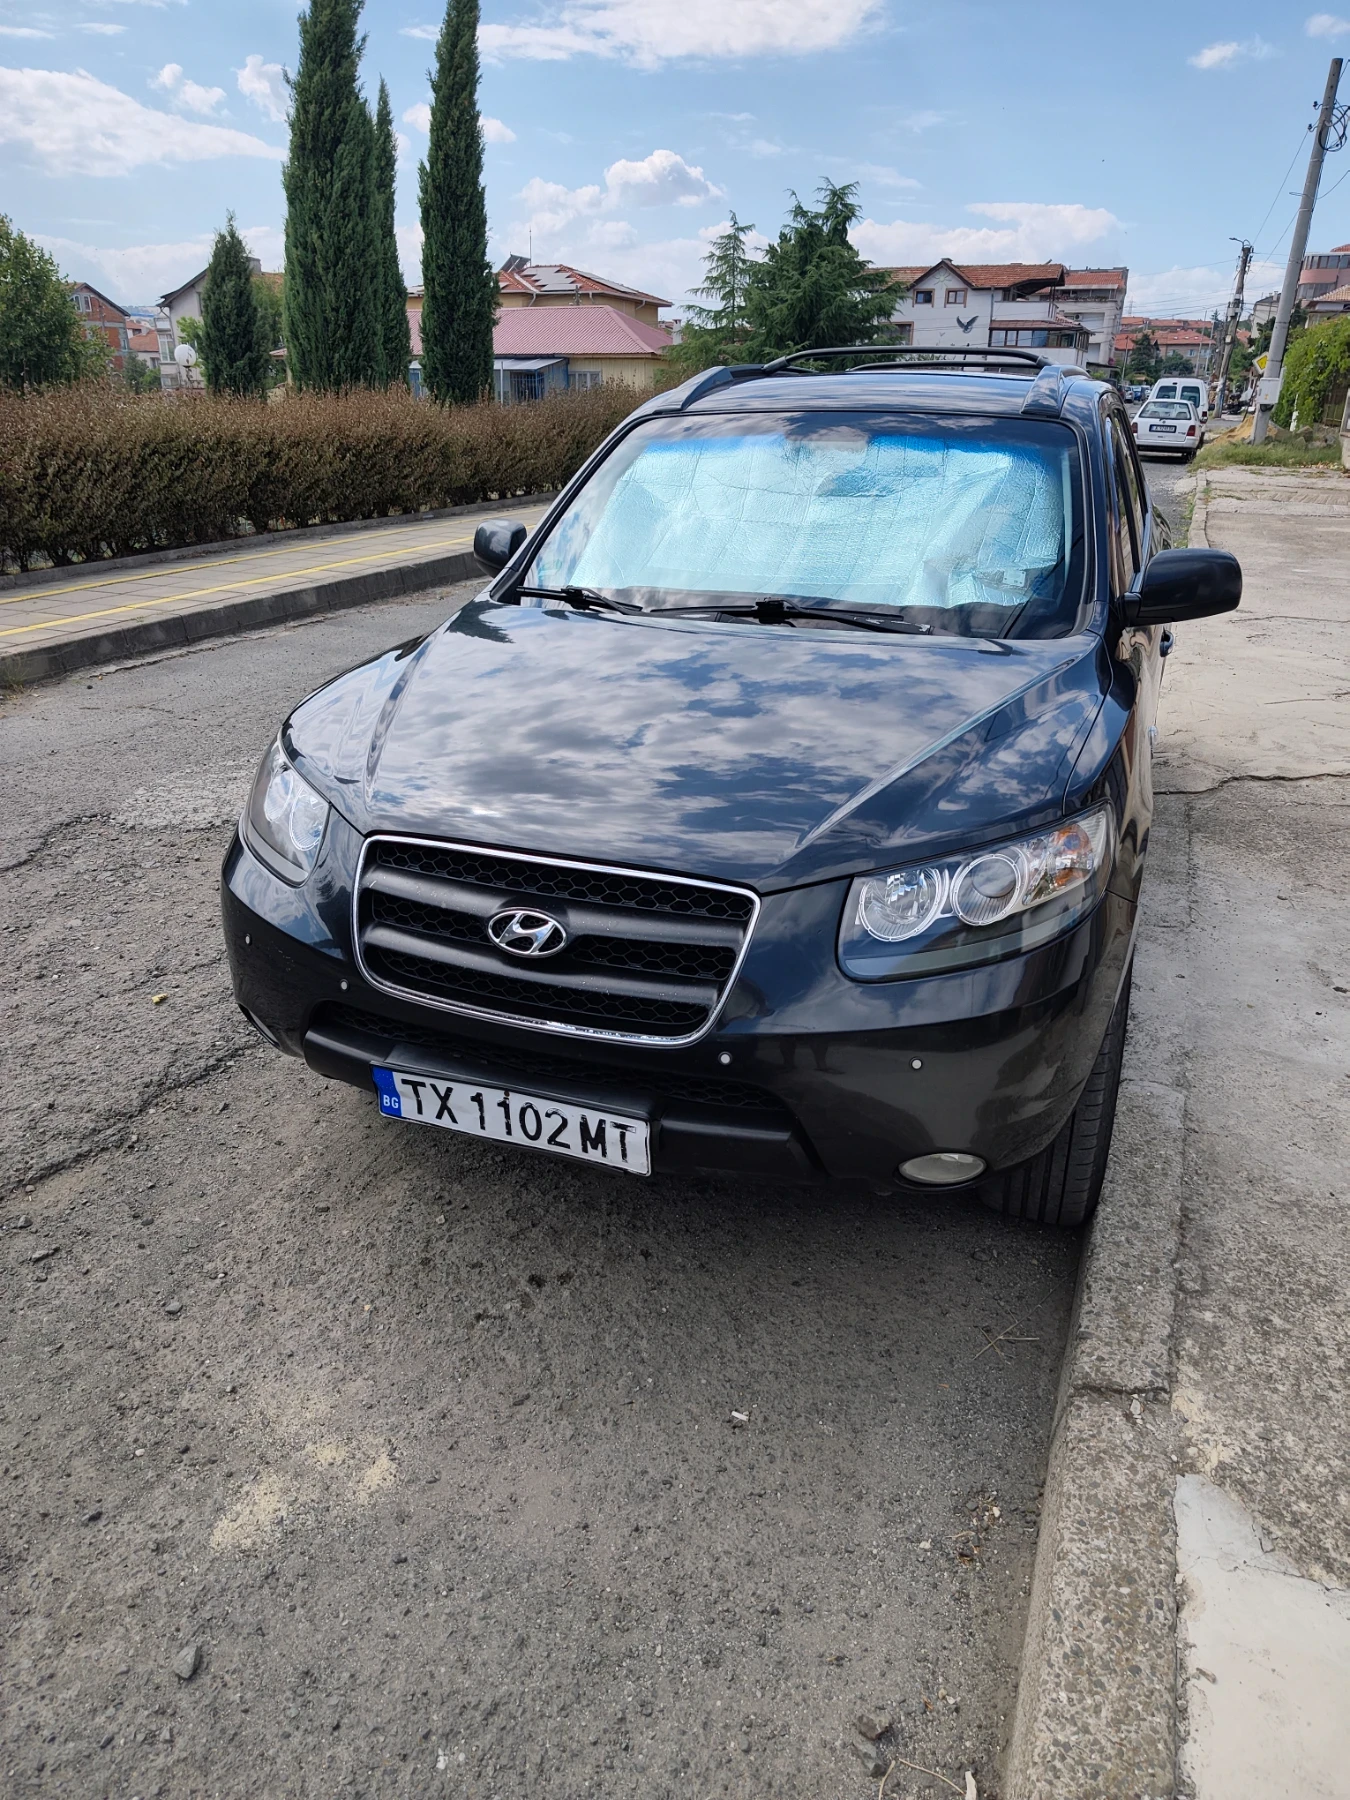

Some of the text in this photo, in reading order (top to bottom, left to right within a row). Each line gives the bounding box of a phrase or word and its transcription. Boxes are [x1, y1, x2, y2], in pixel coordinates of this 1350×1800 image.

[383, 1094, 399, 1109] BG
[401, 1078, 636, 1163] TX 1102 MT
